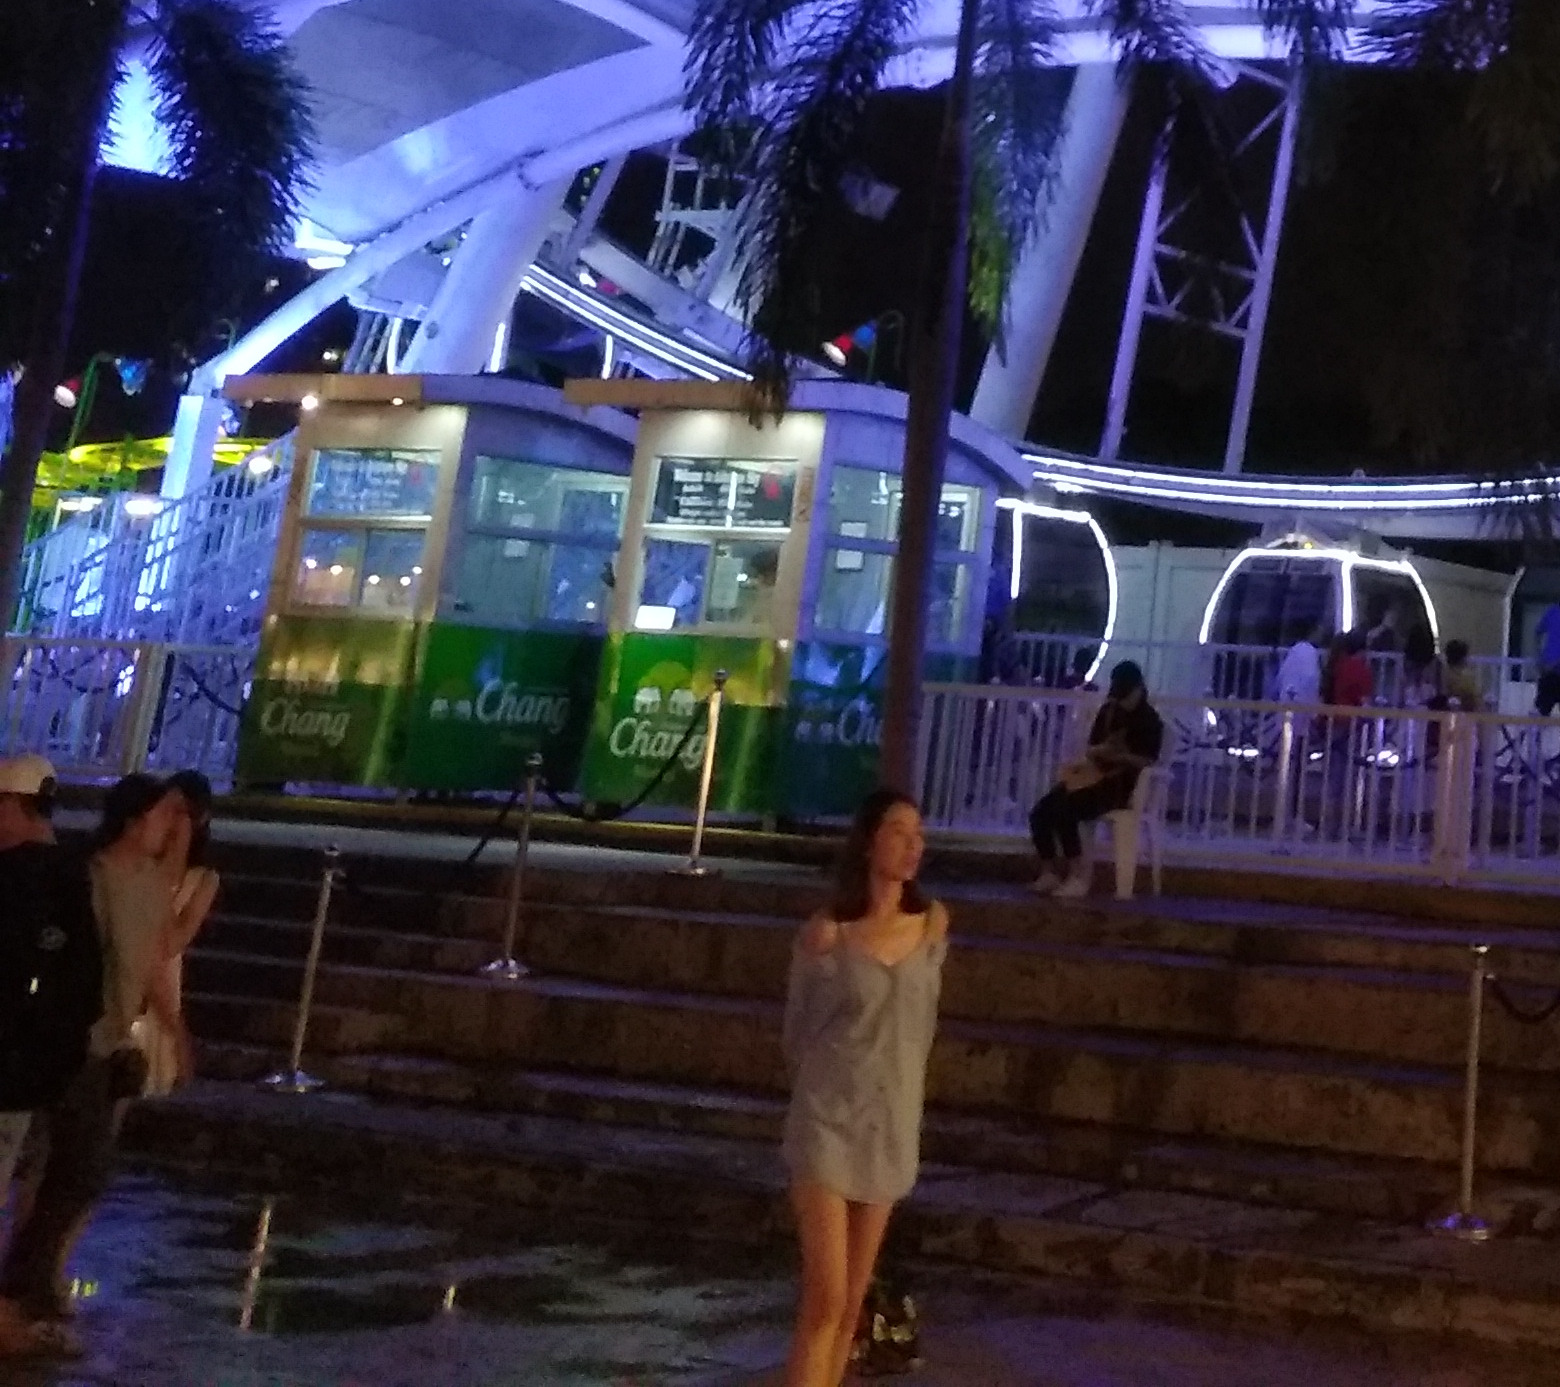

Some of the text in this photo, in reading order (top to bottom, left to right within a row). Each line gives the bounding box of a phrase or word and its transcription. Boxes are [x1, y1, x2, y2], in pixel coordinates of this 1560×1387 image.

[260, 697, 351, 747] Chang
[476, 677, 571, 734] Chang
[608, 716, 706, 770] Chang
